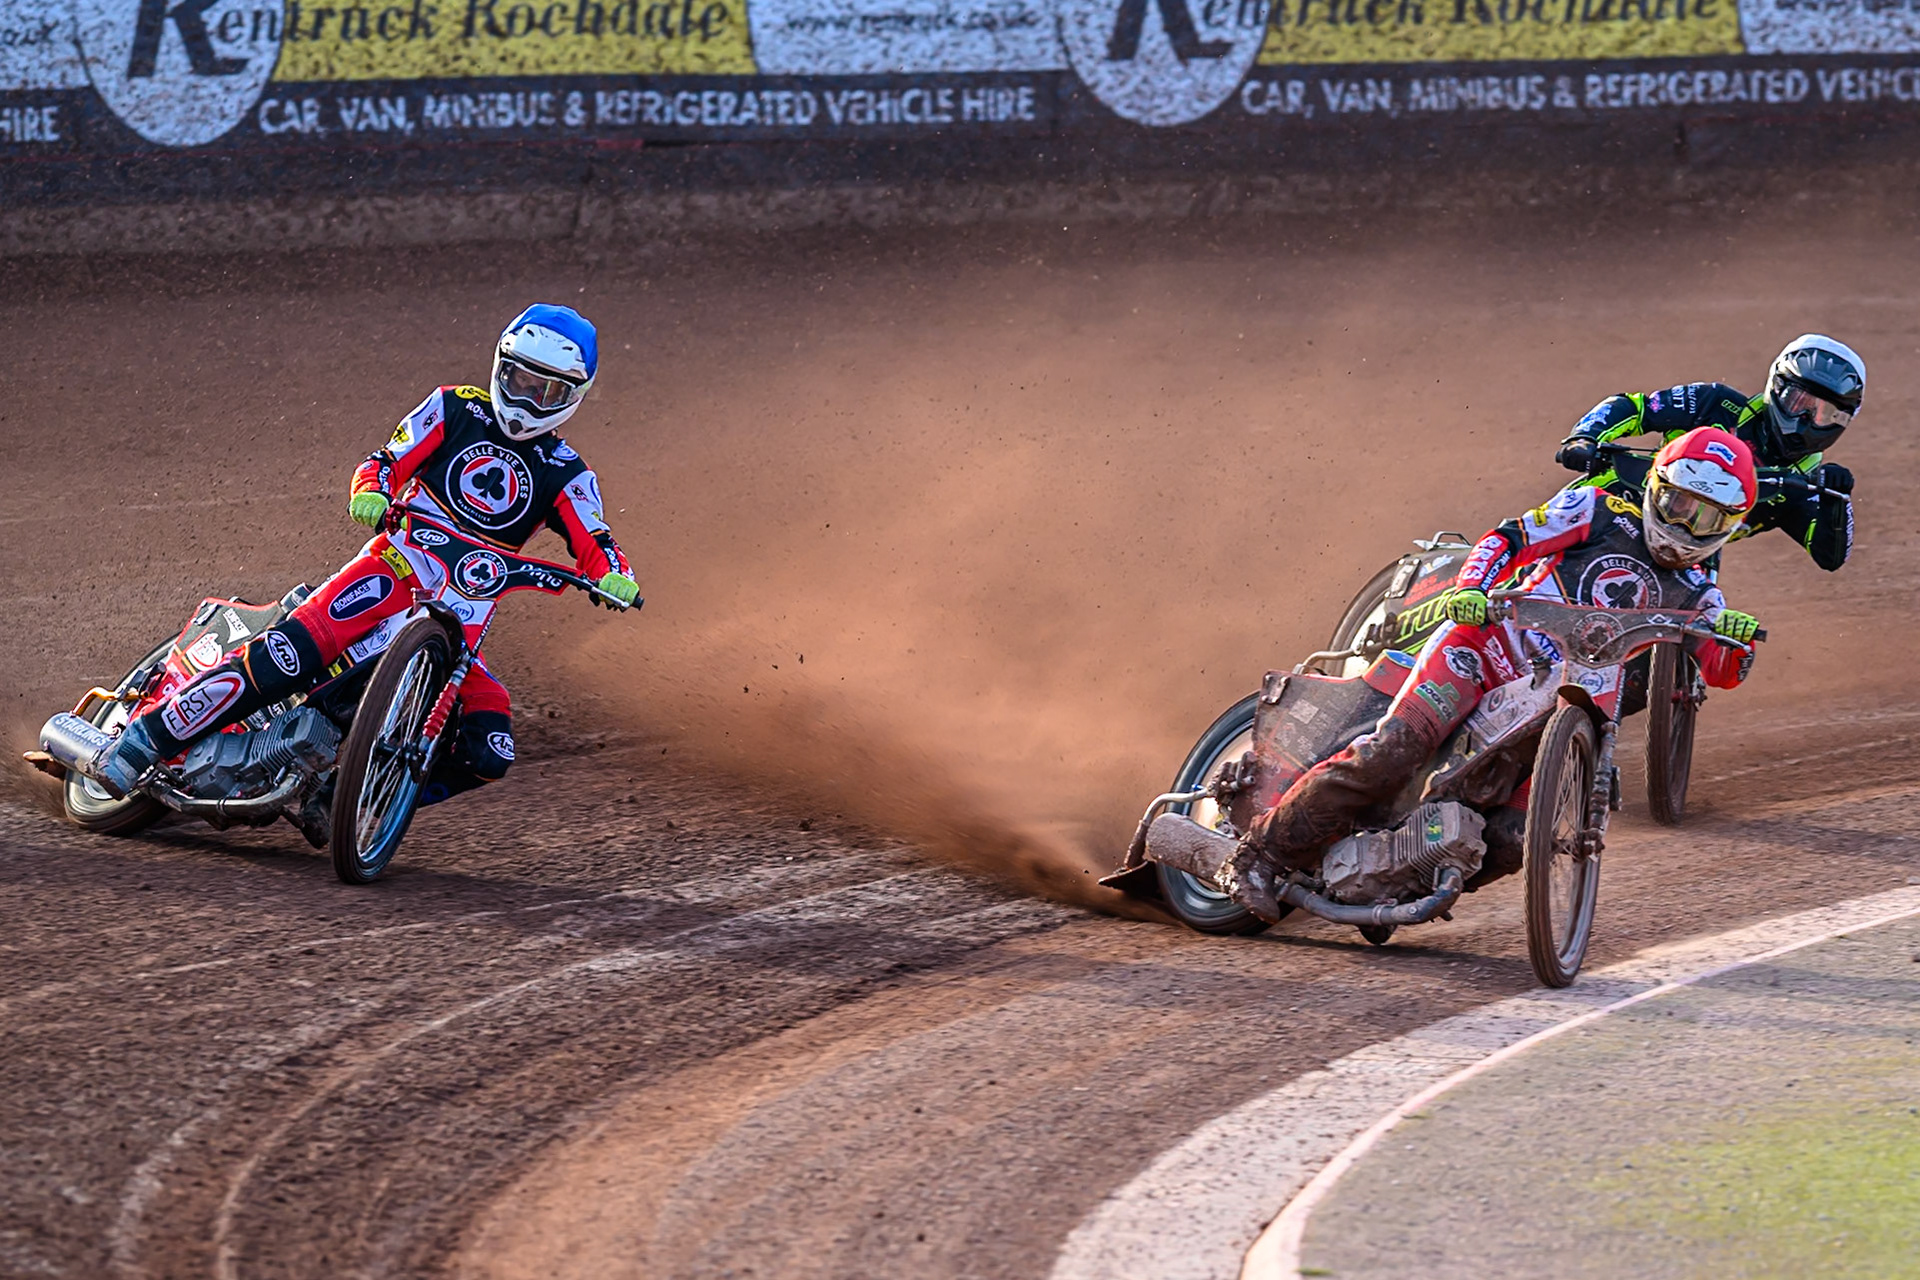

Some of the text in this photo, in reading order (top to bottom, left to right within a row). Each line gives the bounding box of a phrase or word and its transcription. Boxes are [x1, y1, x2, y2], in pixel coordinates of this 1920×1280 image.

[564, 90, 586, 126] &
[823, 88, 954, 125] VEHICLE
[961, 86, 1036, 122] HIRE
[462, 446, 494, 463] BELLE
[499, 450, 520, 469] VUE
[517, 471, 529, 500] ACES
[1601, 558, 1635, 569] BELLE
[332, 582, 372, 613] BONIFACE
[166, 686, 213, 731] FIRST
[55, 716, 112, 747] STARLINGS
